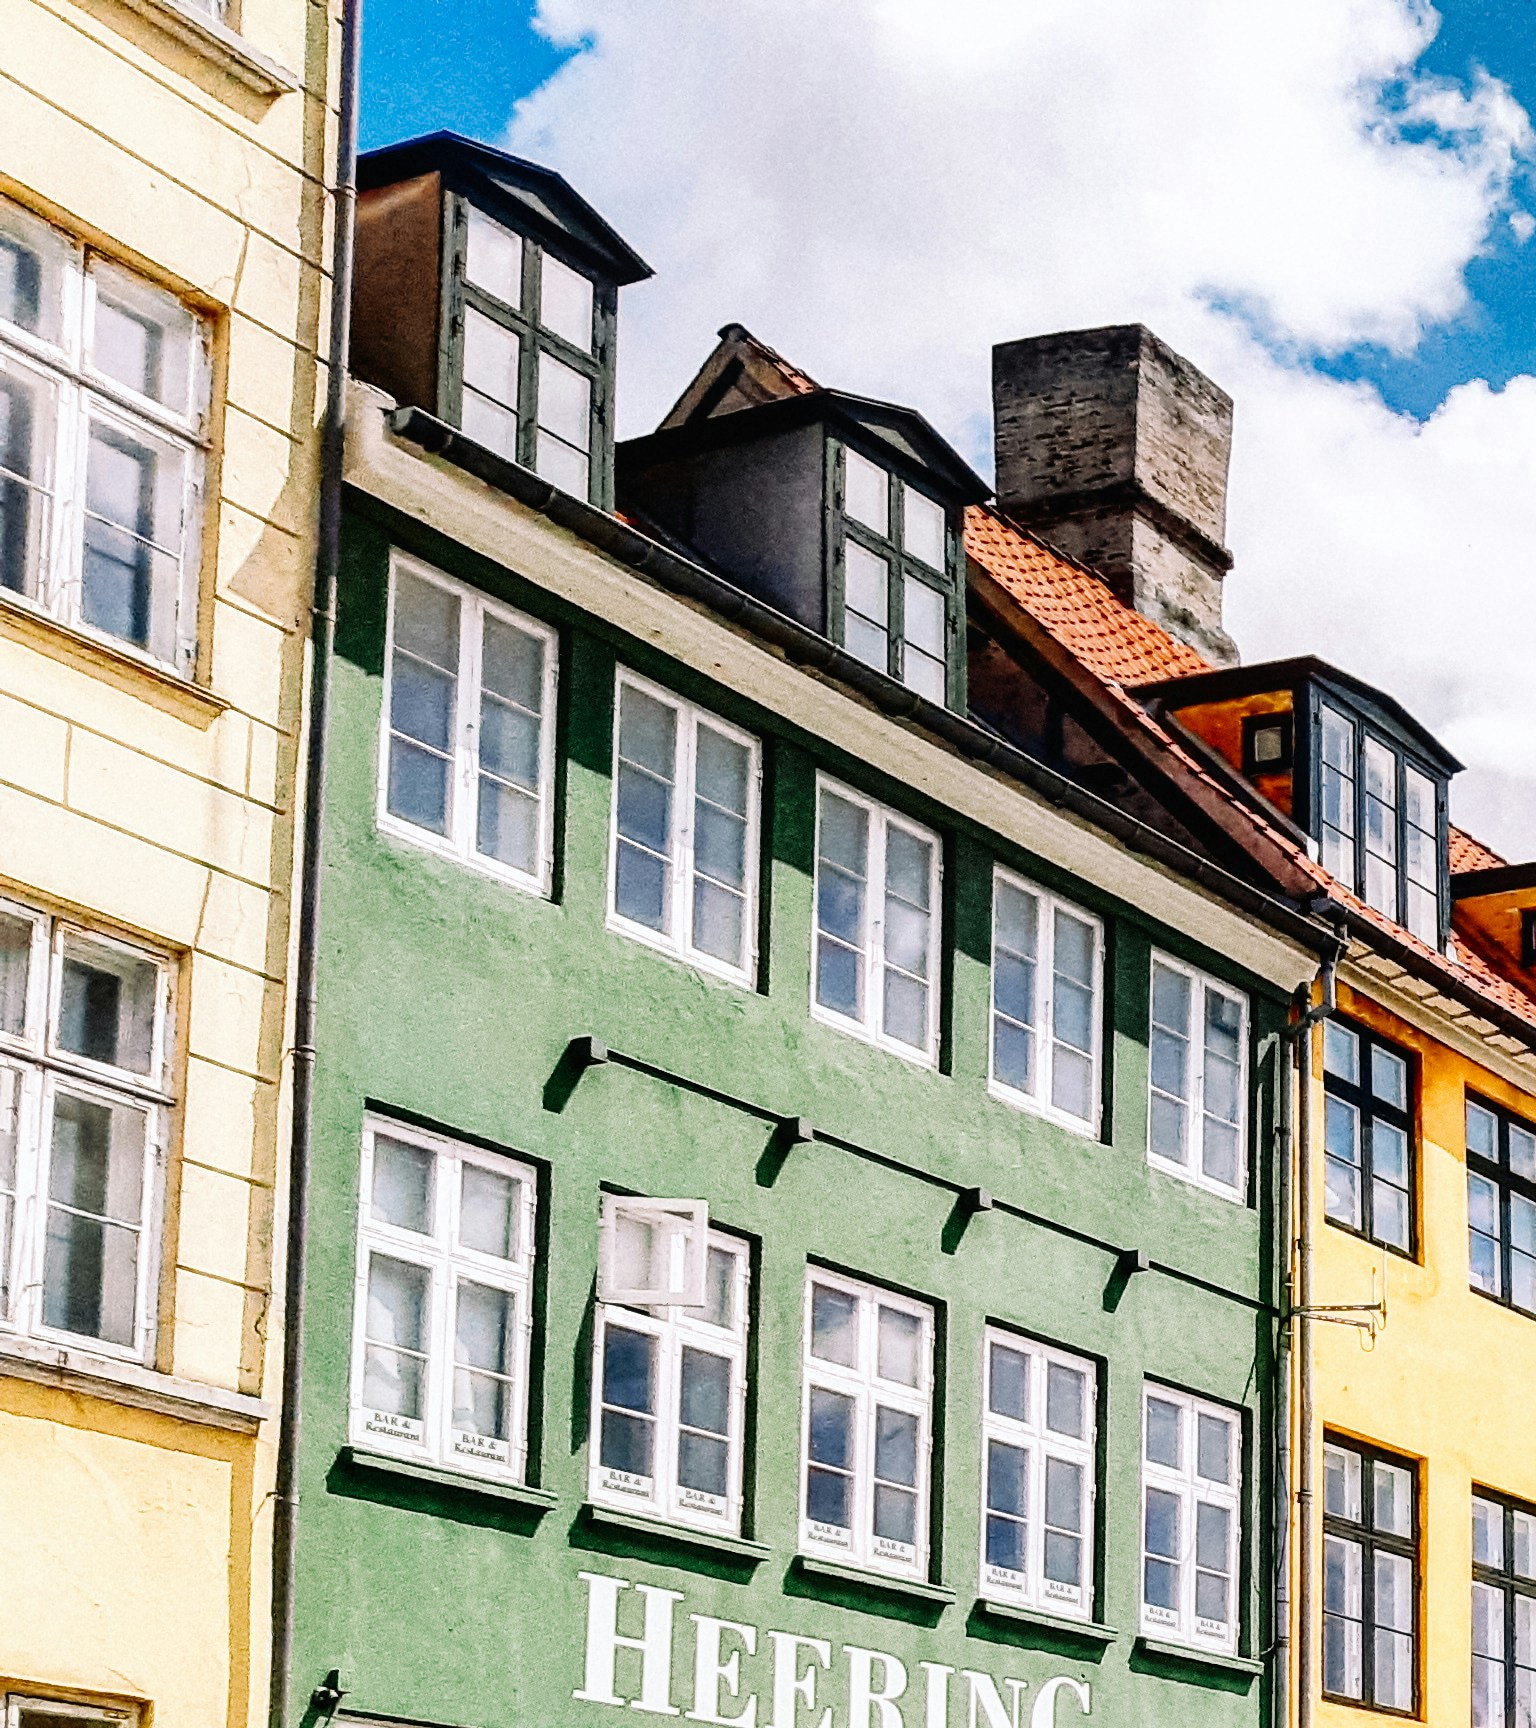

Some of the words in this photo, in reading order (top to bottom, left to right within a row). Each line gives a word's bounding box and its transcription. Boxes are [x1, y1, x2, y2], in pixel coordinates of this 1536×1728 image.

[374, 1413, 399, 1427] BAR
[462, 1434, 485, 1448] BAR
[609, 1471, 630, 1484] BAR
